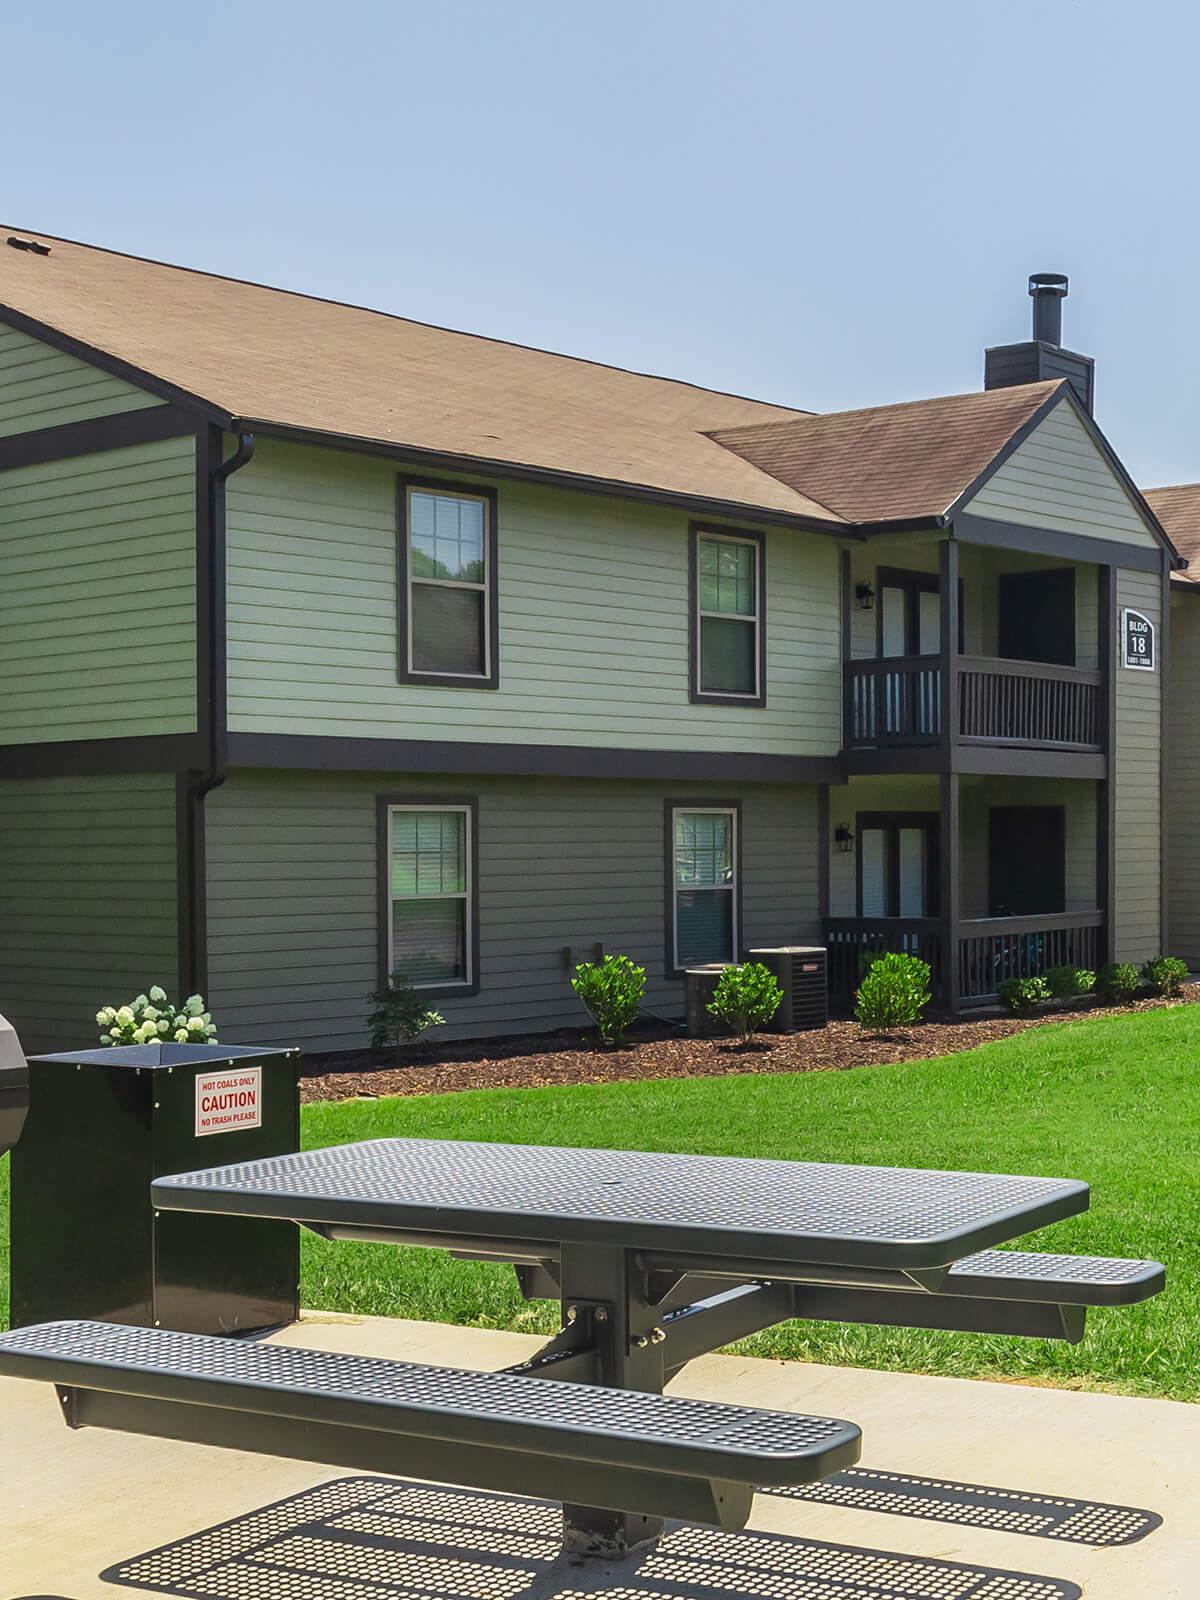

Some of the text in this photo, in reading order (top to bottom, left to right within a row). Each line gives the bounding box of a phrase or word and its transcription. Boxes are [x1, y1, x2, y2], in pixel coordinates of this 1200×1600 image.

[1129, 621, 1148, 632] BLDG
[1132, 636, 1146, 653] 18
[203, 1077, 255, 1091] HOT COALS ONLY
[202, 1091, 256, 1112] CAUTION
[201, 1111, 256, 1127] NO TRASH PLEASE
